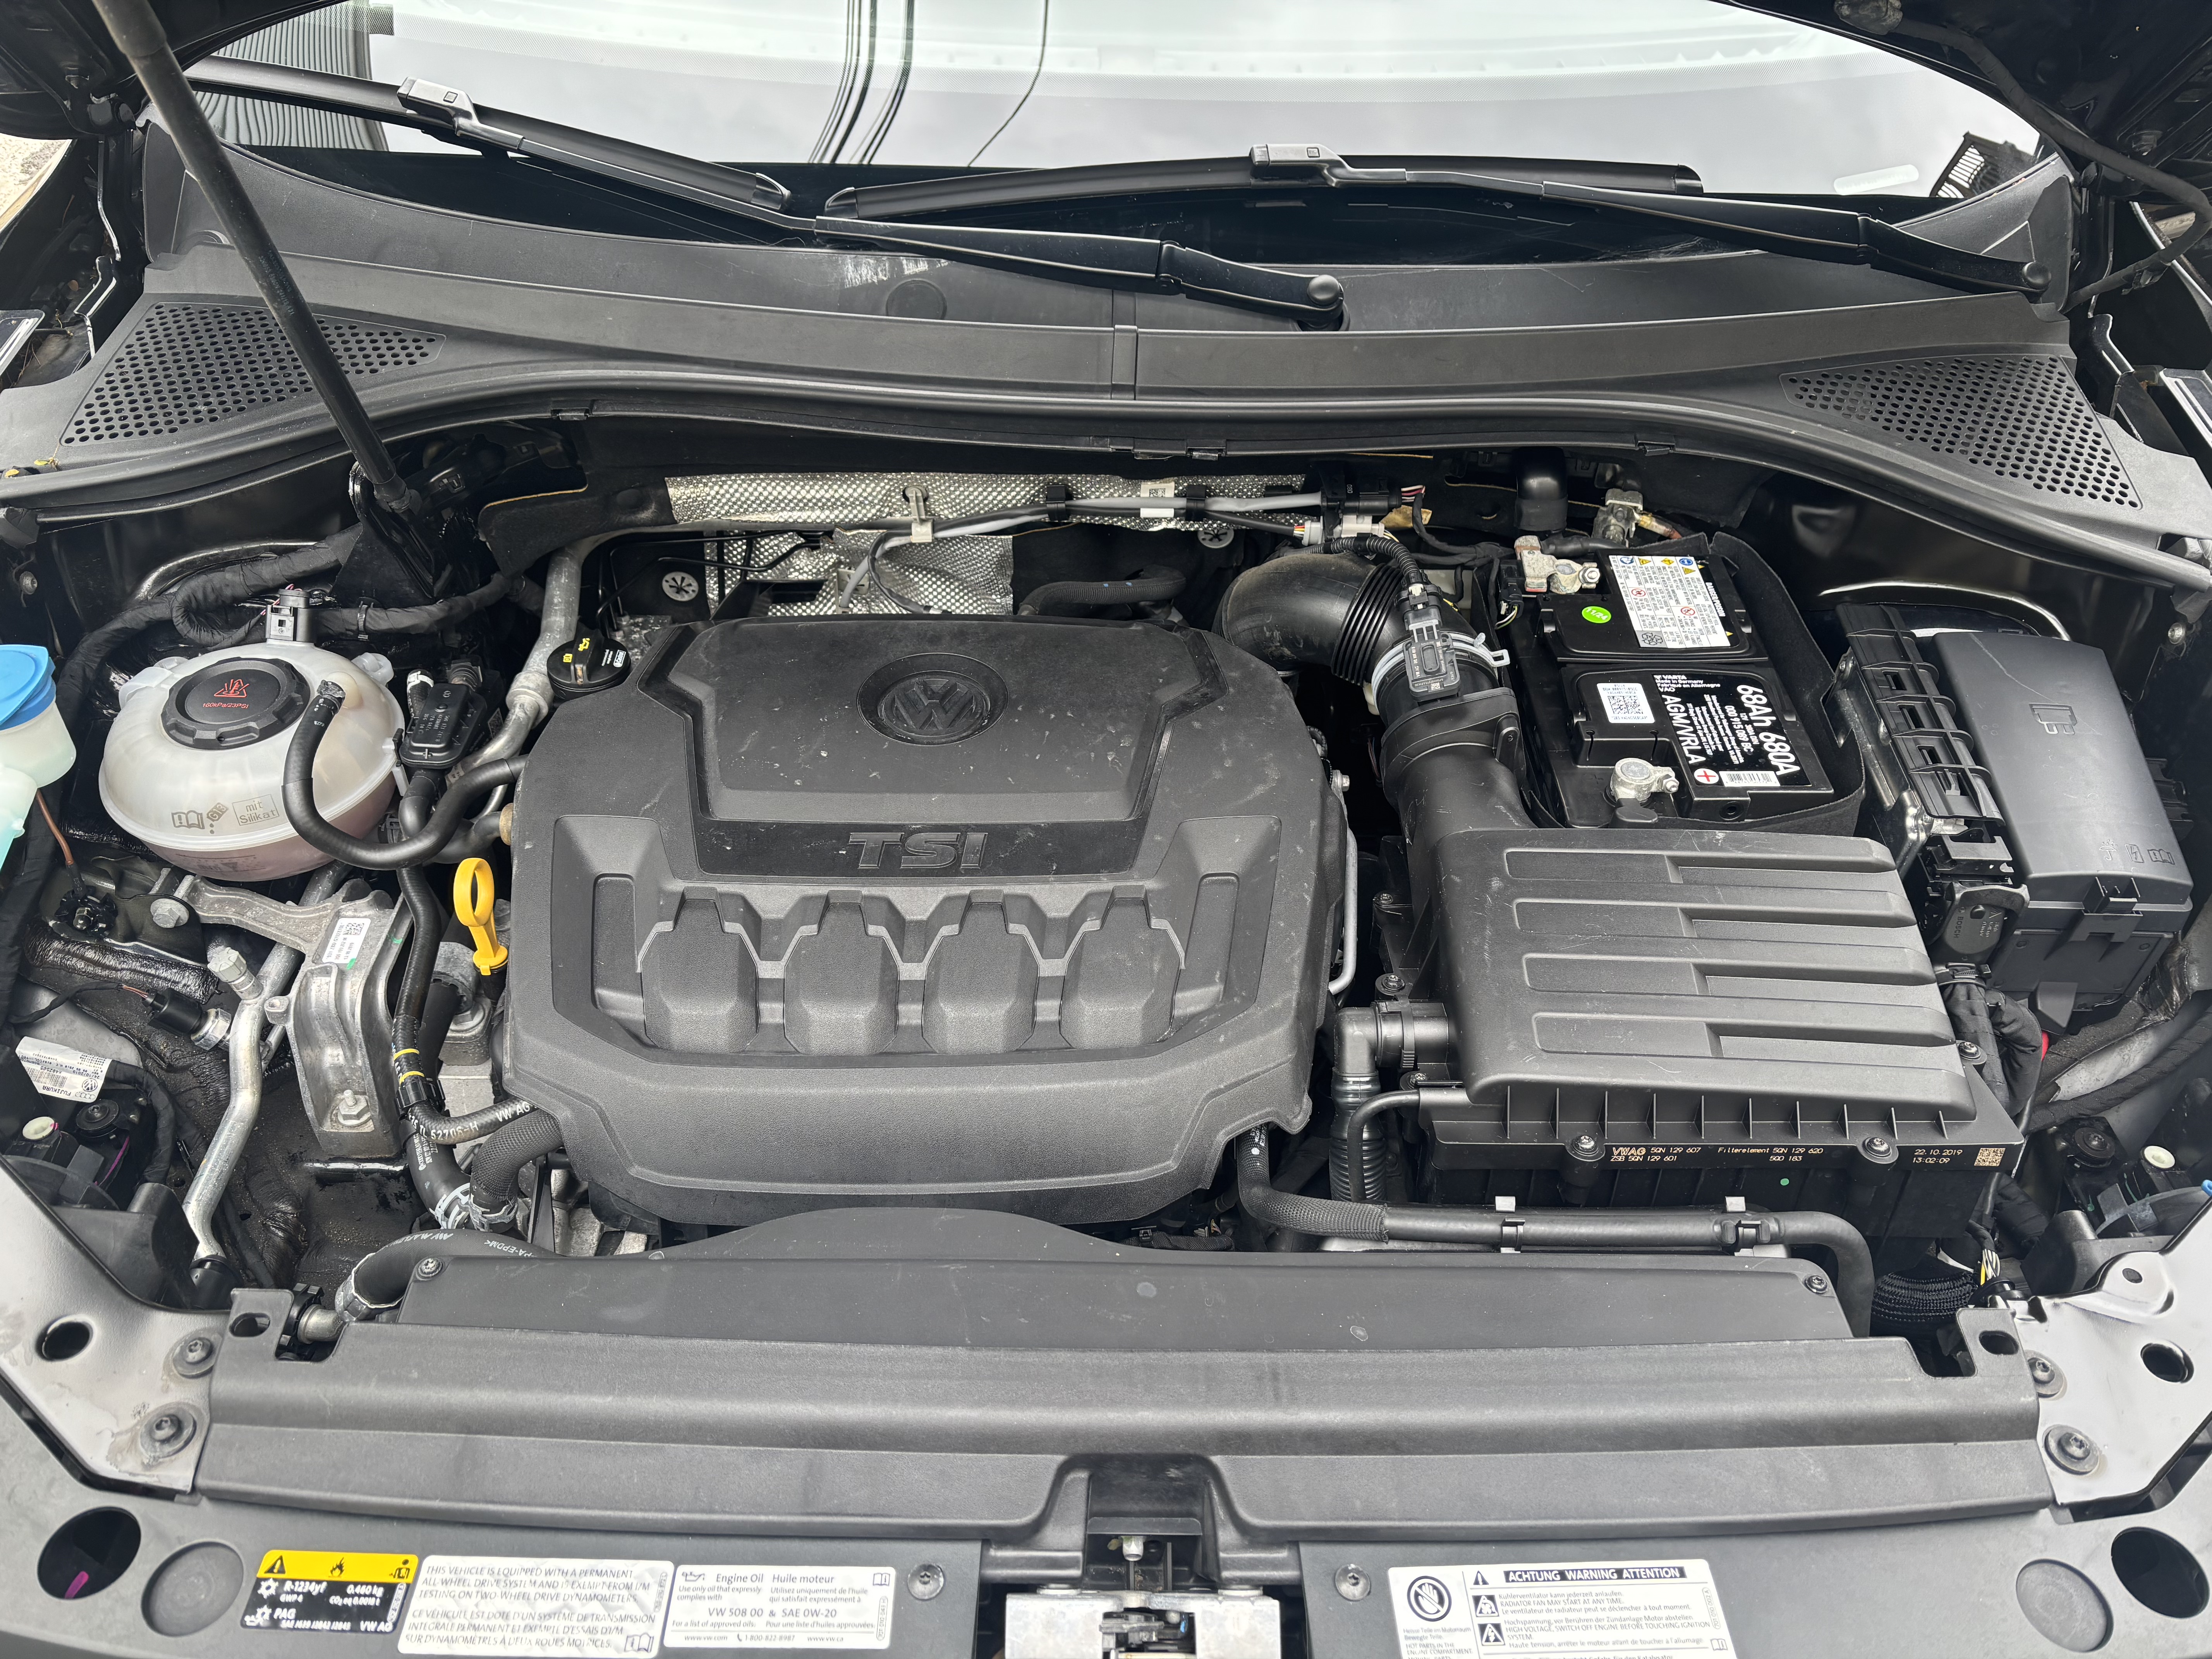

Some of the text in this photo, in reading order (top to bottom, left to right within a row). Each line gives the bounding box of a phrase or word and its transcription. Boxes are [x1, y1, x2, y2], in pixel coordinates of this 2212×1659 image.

[1661, 694, 1706, 764] AGM/VRLA
[1724, 706, 1754, 752] 000 915 089 BC
[1736, 685, 1800, 775] 68Ah 680A
[209, 802, 227, 820] G13
[245, 799, 263, 811] mit
[239, 808, 278, 824] Silikat
[847, 832, 988, 869] TSI
[1953, 916, 1964, 938] BOSCH
[42, 1085, 71, 1096] FUJIKURA
[495, 1102, 531, 1122] VW AG
[1613, 1147, 1646, 1156] VWAG
[427, 1566, 633, 1578] THIS VEHICLE IS EQUIPPED WITH A PERMANENT
[1509, 1567, 1680, 1582] ACHTUNG WARNING ATTENTION
[474, 1578, 499, 1587] DRIVE
[503, 1579, 537, 1588] SYSTEM
[539, 1580, 558, 1588] AND
[571, 1580, 606, 1589] EXEMPT
[608, 1582, 633, 1591] FROM
[635, 1582, 650, 1591] I/M
[716, 1573, 835, 1585] Engine Oil Huile moteur
[419, 1590, 455, 1599] TESTING
[458, 1590, 473, 1599] ON
[534, 1592, 560, 1601] DRIVE
[692, 1585, 706, 1594] only
[732, 1587, 762, 1595] expressly
[677, 1594, 706, 1602] complies
[769, 1596, 780, 1604] qui
[809, 1595, 855, 1604] expressément
[273, 1608, 297, 1619] PAG
[412, 1609, 422, 1618] CE
[470, 1610, 485, 1620] EST
[513, 1611, 536, 1620] D'UN
[577, 1614, 589, 1622] DE
[591, 1614, 655, 1623] TRANSMISSION
[708, 1607, 726, 1616] VW
[729, 1608, 747, 1617] 508
[750, 1608, 763, 1617] 00
[782, 1608, 800, 1618] SAE
[803, 1608, 837, 1618] 0W-20
[360, 1620, 393, 1632] VW AG
[457, 1623, 510, 1633] PERMANENT
[511, 1625, 520, 1633] ET
[710, 1620, 741, 1629] approved
[405, 1634, 422, 1643] SUR
[508, 1637, 532, 1646] DEUX
[535, 1638, 564, 1647] ROUES
